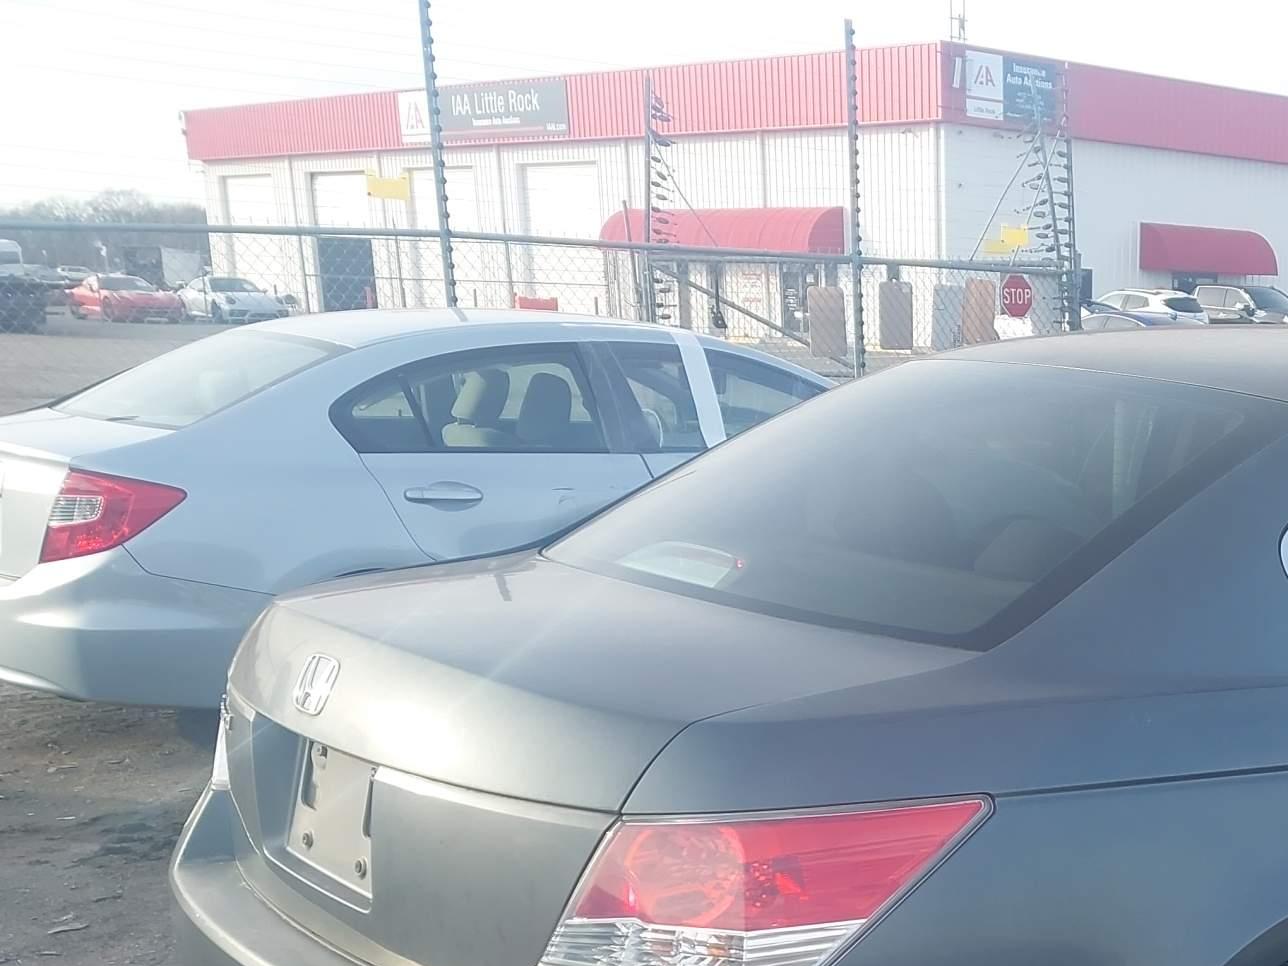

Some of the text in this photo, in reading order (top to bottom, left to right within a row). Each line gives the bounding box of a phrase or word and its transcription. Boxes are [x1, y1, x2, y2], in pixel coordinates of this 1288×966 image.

[451, 88, 540, 116] IAA Little Rock
[1003, 287, 1031, 305] STOP
